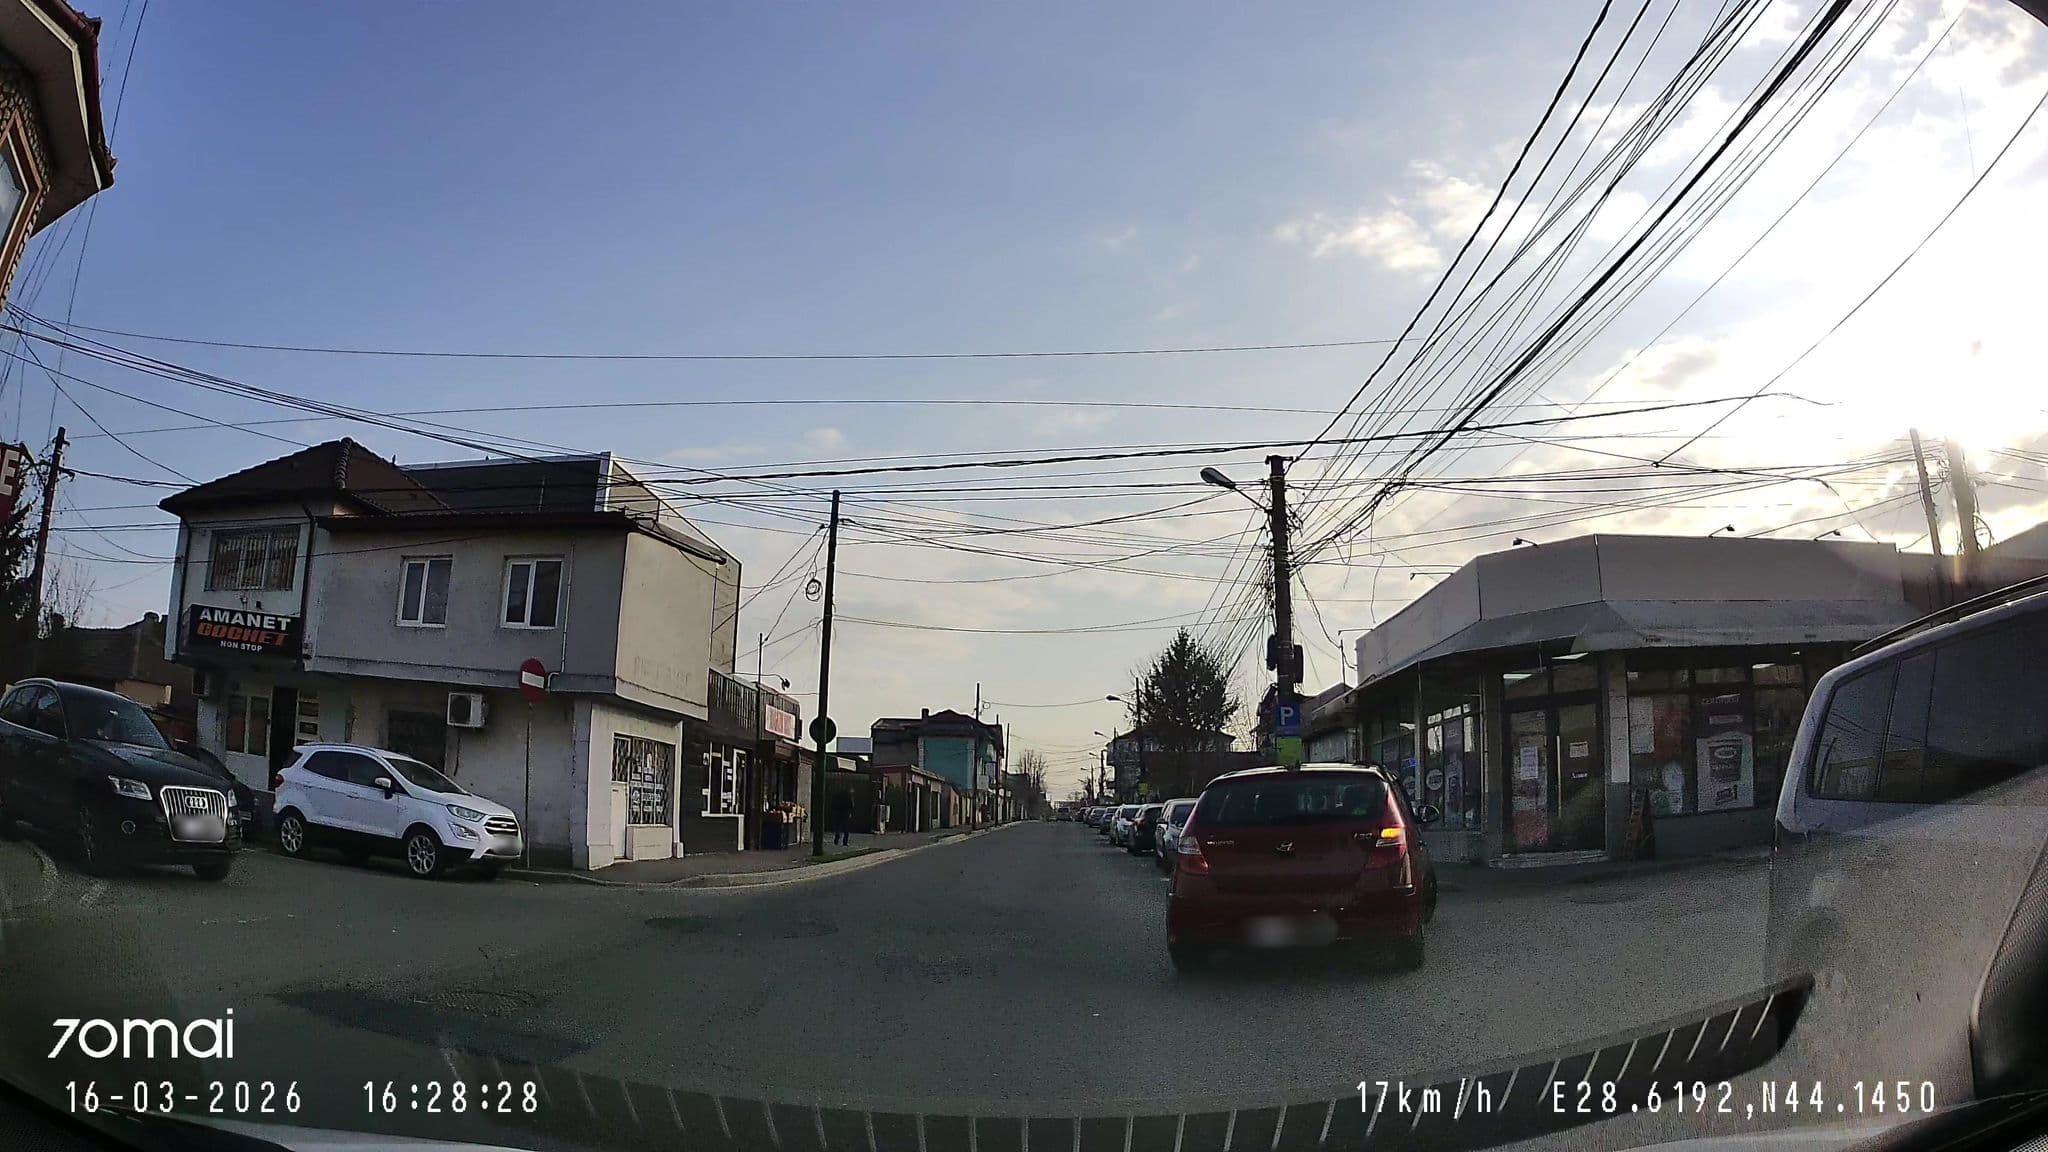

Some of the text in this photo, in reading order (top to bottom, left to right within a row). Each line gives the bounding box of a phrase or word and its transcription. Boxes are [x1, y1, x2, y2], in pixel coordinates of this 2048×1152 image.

[200, 607, 291, 631] AMANET
[220, 640, 263, 652] NON STOP
[1280, 706, 1294, 726] P
